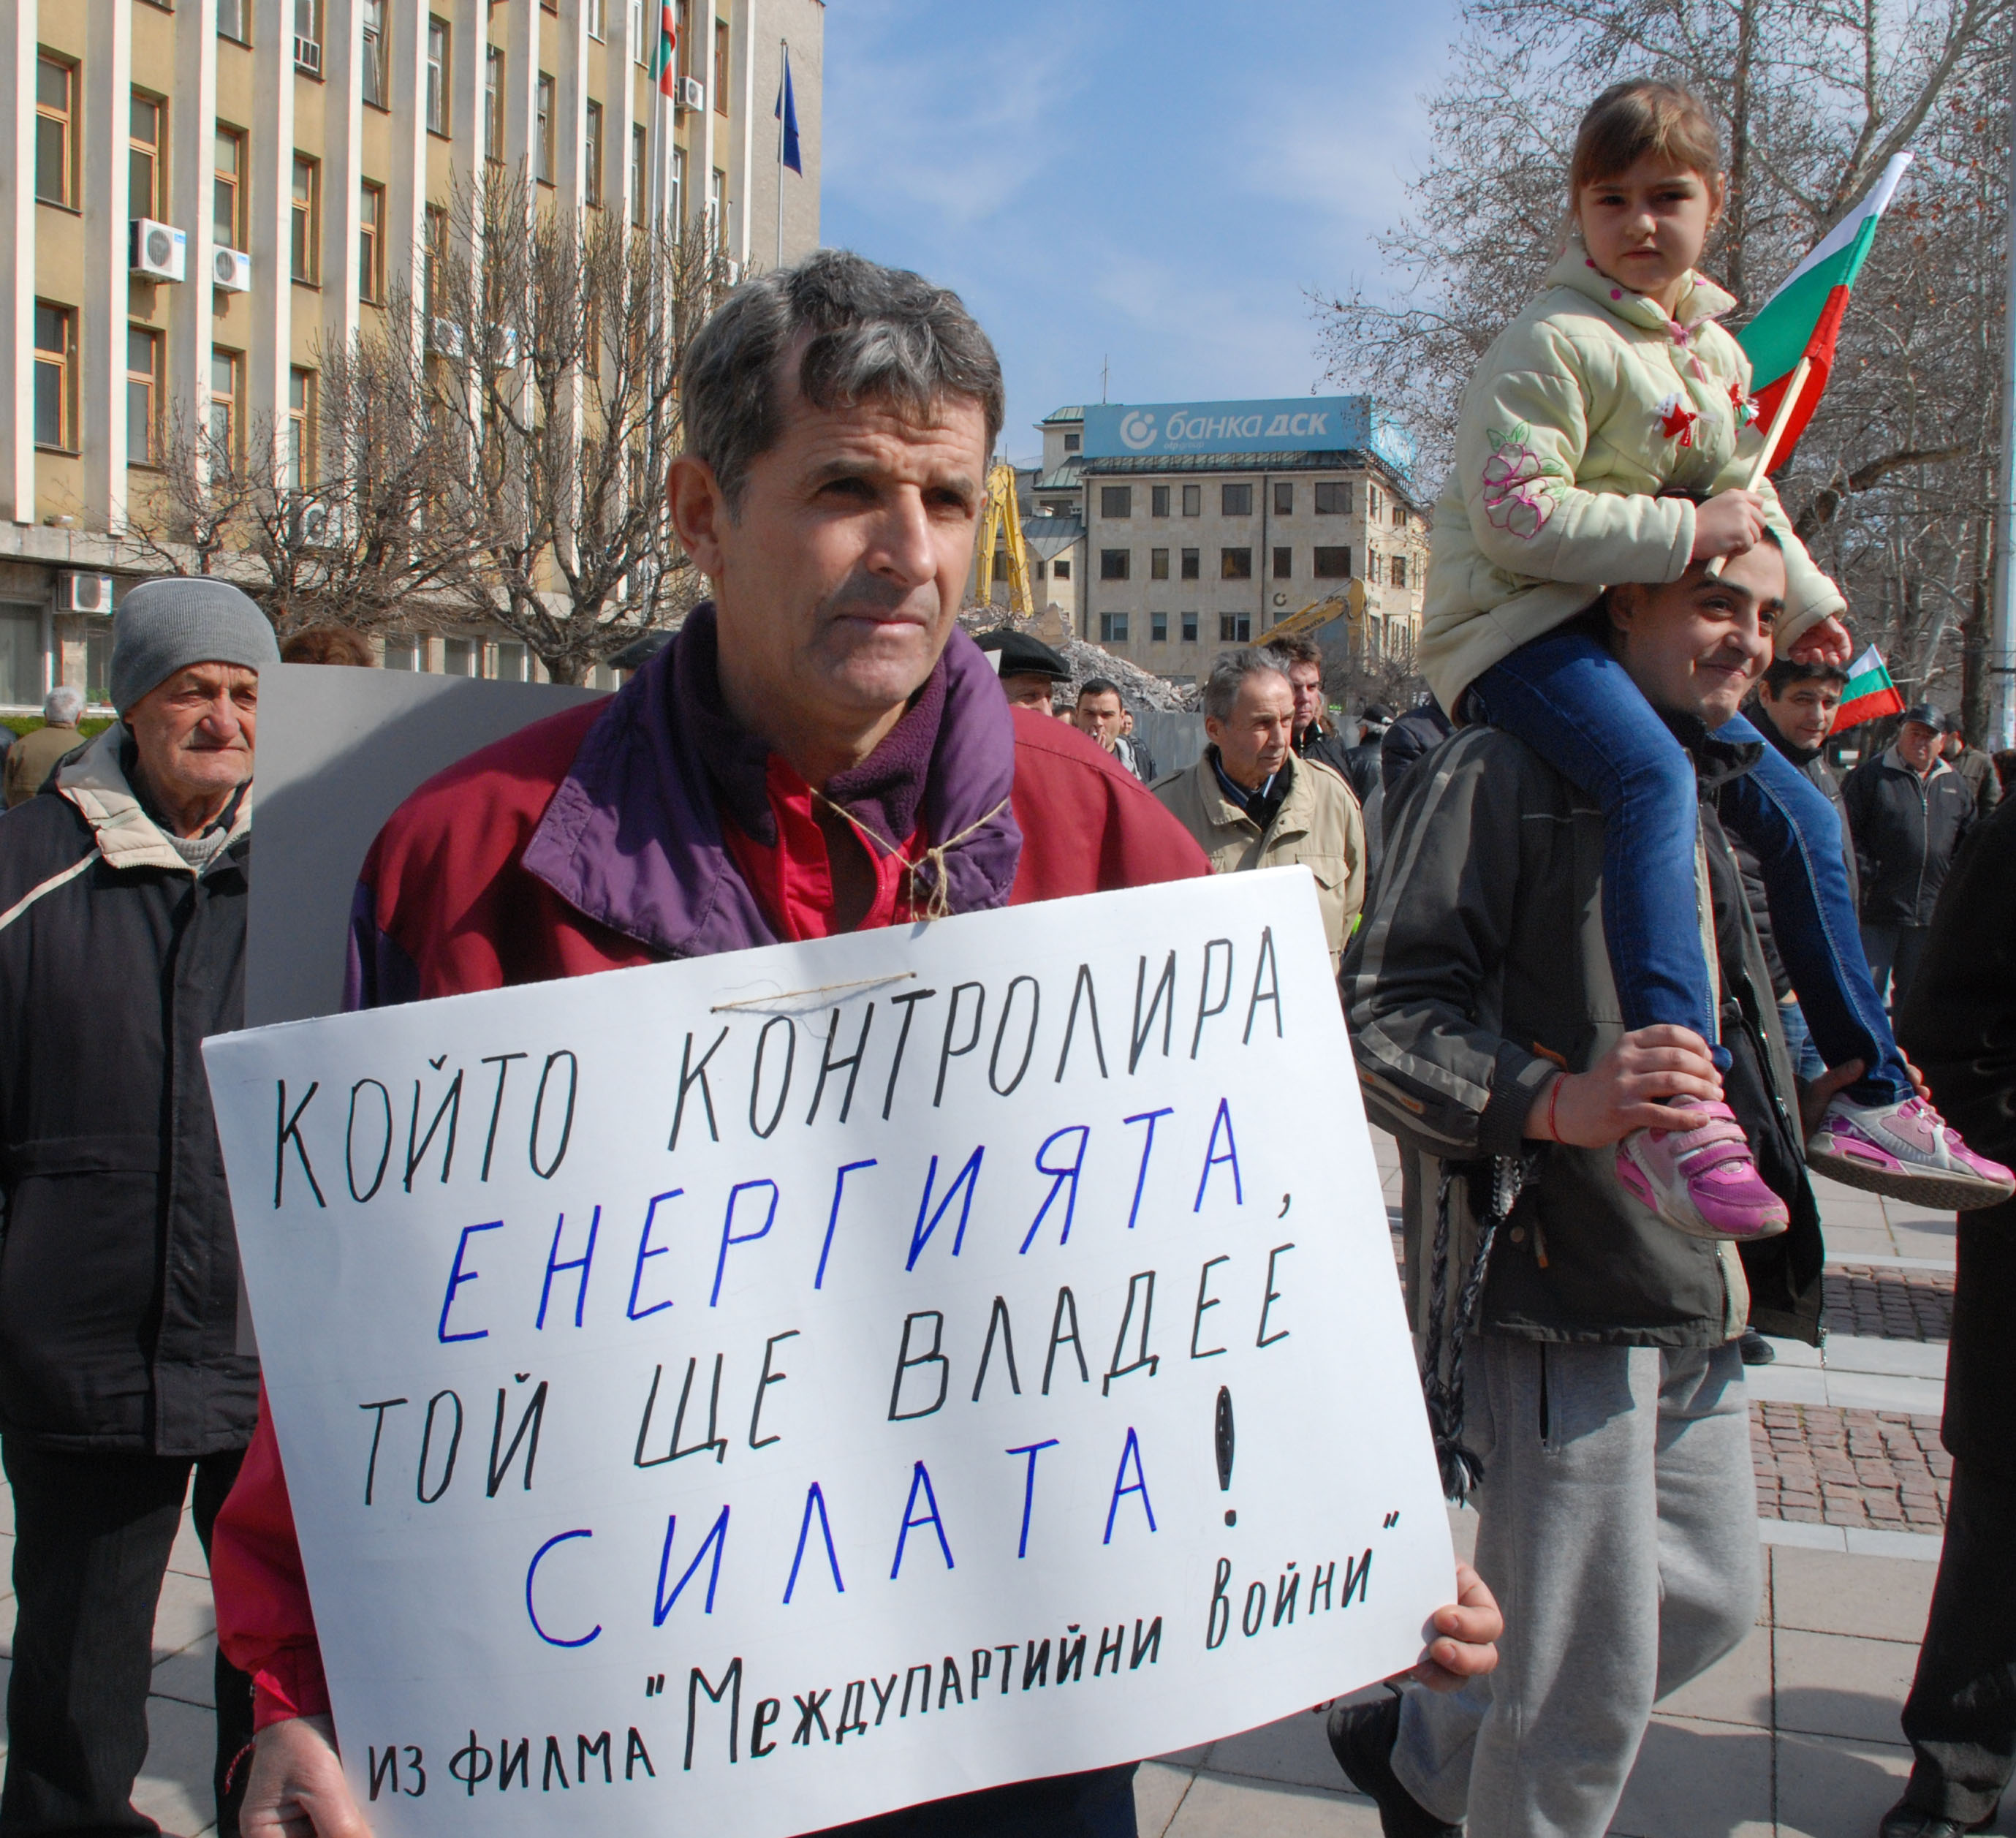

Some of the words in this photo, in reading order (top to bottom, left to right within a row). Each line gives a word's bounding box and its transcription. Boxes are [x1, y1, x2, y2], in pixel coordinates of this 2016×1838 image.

[1166, 411, 1263, 440] банка
[1265, 412, 1328, 436] ДСК
[273, 1049, 579, 1211] КОЙТО
[667, 926, 1284, 1153] КОНТРОЛИРА
[438, 1097, 1292, 1345] ЕНЕРГИЯТА,
[359, 1372, 549, 1506] ТОЙ
[634, 1330, 800, 1469] ЩЕ
[887, 1244, 1295, 1421] ВЛАДЕЕ
[526, 1385, 1237, 1648] СИЛАТА!
